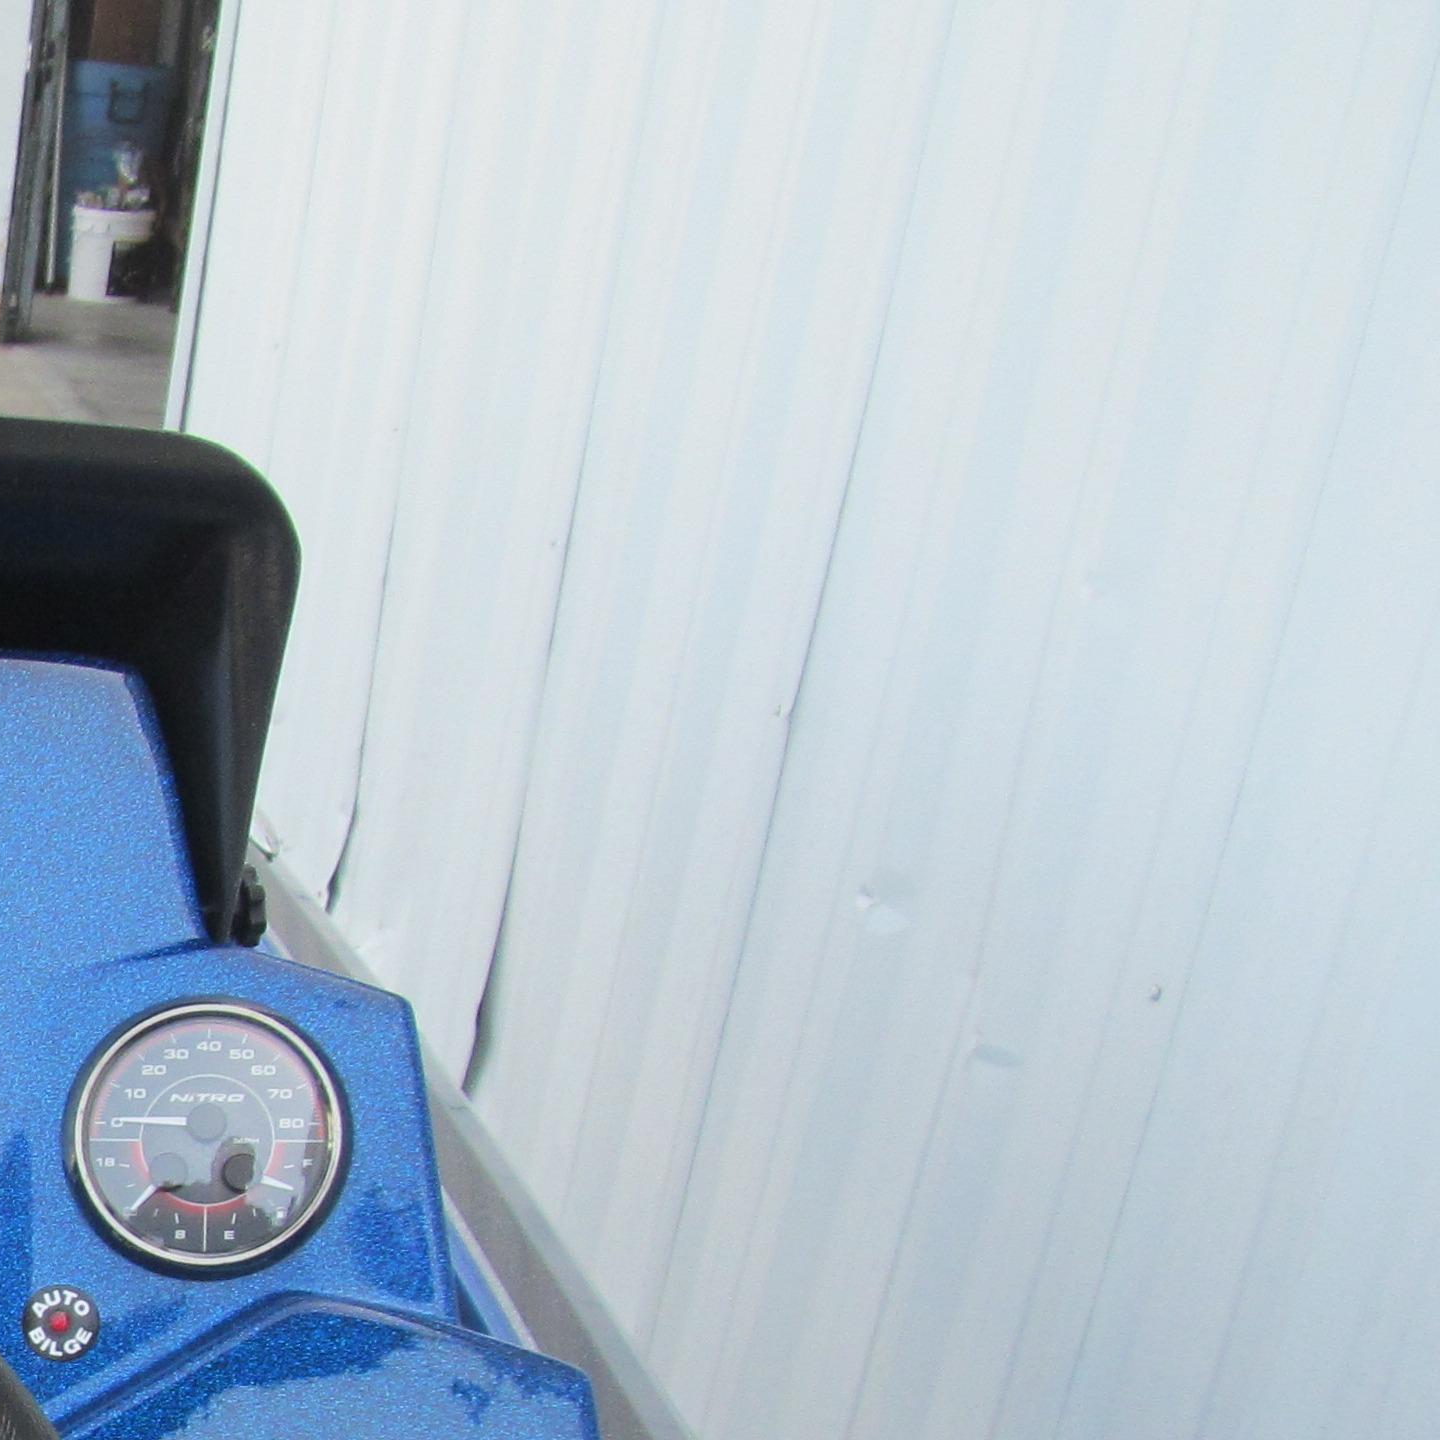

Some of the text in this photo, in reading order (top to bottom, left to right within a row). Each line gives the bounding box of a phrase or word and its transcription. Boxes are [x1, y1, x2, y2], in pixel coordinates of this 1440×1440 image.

[196, 1041, 222, 1052] 40
[163, 1049, 189, 1060] 30
[229, 1049, 255, 1060] 50
[141, 1064, 167, 1075] 20
[251, 1064, 276, 1076] 60
[125, 1088, 146, 1099] 10
[267, 1088, 293, 1100] 70
[110, 1118, 124, 1128] 0
[278, 1118, 305, 1129] 80
[303, 1158, 313, 1168] F
[224, 1230, 235, 1240] E
[31, 1289, 90, 1319] AUTO
[28, 1326, 93, 1357] BILGE
